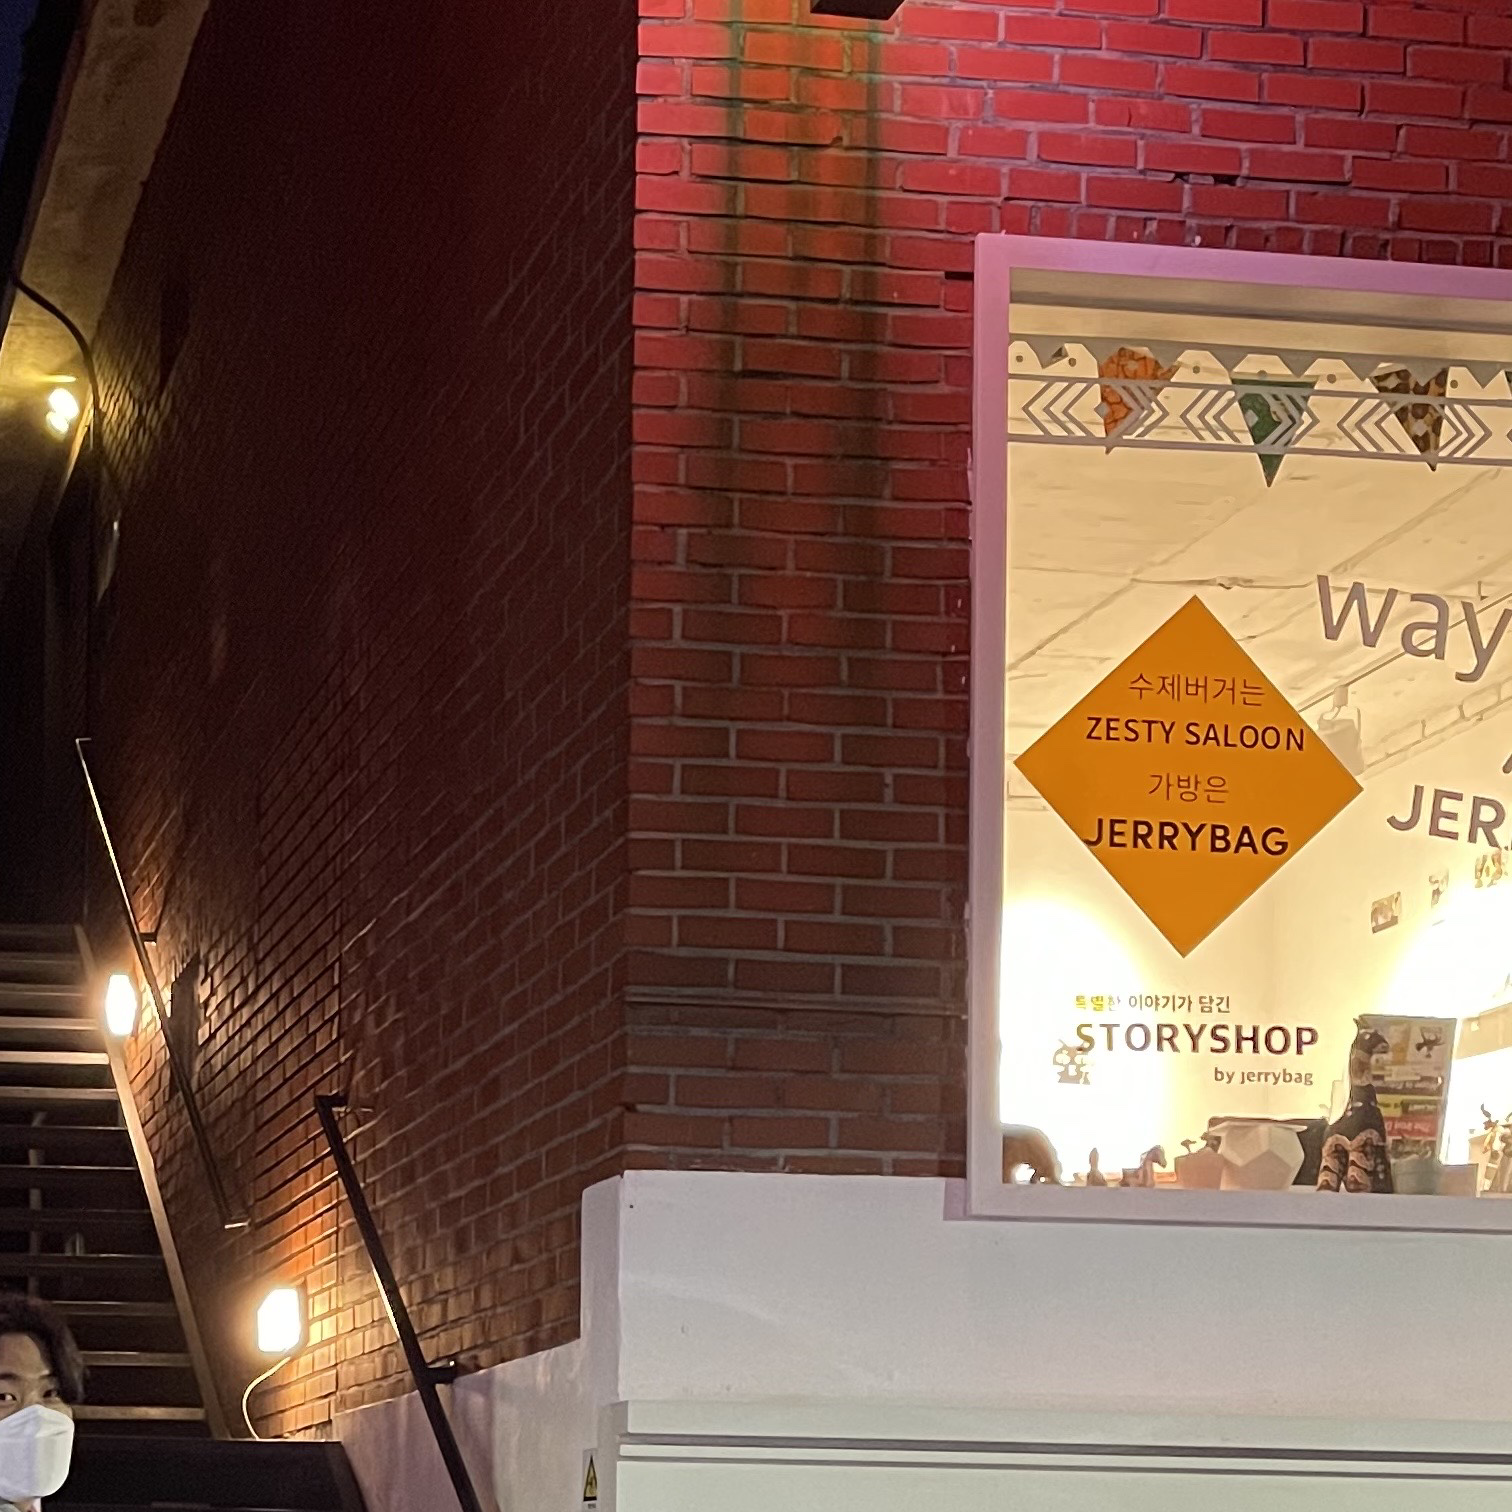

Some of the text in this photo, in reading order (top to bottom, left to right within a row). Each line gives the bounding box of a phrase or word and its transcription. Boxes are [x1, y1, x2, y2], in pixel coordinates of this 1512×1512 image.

[1128, 673, 1266, 706] 수제버거는
[1086, 717, 1305, 752] ZESTY SALOON
[1148, 772, 1230, 804] 가방은
[1387, 784, 1512, 852] JER
[1083, 817, 1289, 856] JERRYBAG
[1128, 994, 1192, 1013] 이야기가
[1198, 995, 1231, 1014] 담긴
[1075, 1022, 1319, 1056] STORYSHOP
[1213, 1066, 1314, 1086] by jerrybag
